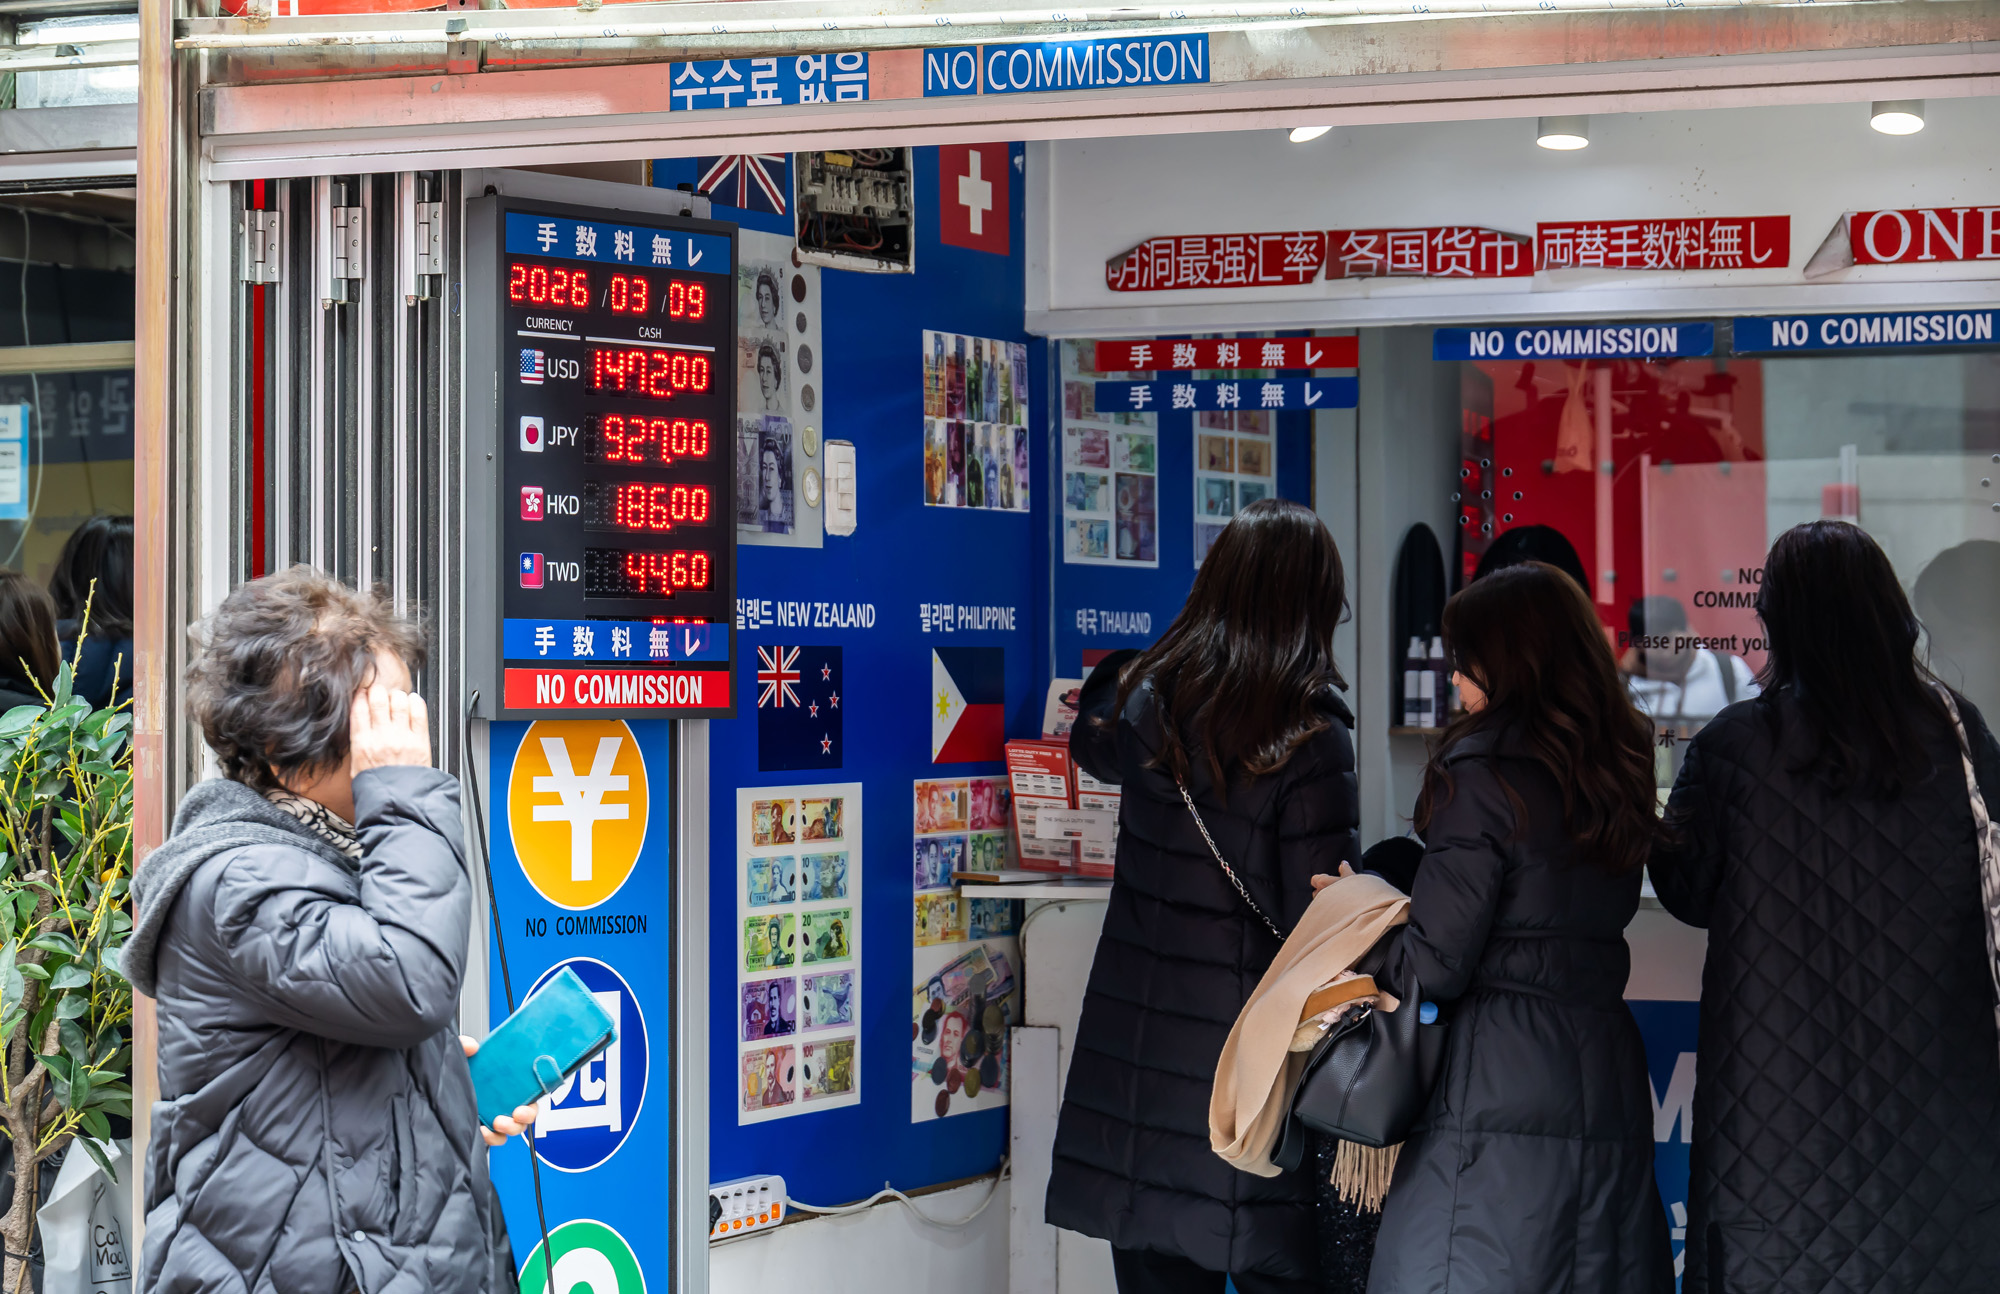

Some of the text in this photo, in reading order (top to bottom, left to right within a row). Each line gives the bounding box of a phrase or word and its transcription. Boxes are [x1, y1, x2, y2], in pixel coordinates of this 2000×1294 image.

[928, 39, 1204, 92] NO COMMISSION
[672, 57, 783, 111] 수수료
[510, 264, 590, 308] 2026
[525, 315, 574, 332] CURRENCY
[638, 326, 662, 339] CASH
[1772, 313, 1992, 347] NO COMMISSION
[1469, 327, 1678, 357] NO COMMISSION
[547, 358, 580, 380] USD
[547, 426, 579, 447] JPY
[546, 494, 580, 515] HKD
[546, 561, 580, 582] TWD
[1738, 568, 1765, 584] NO
[777, 602, 811, 628] NEW
[813, 602, 876, 629] ZEALAND
[919, 602, 1016, 632] 필리핀 PHILIPPINE
[1075, 609, 1152, 635] 태국 THAILAND
[1618, 631, 1669, 649] Please
[1674, 634, 1738, 654] present
[536, 674, 702, 705] NO COMMISSION
[802, 857, 810, 868] 10
[802, 914, 812, 926] 20
[843, 910, 850, 919] 20
[525, 914, 648, 937] NO COMMISSION
[749, 956, 765, 964] TWENTY
[804, 979, 813, 991] 50
[803, 1045, 814, 1058] 100
